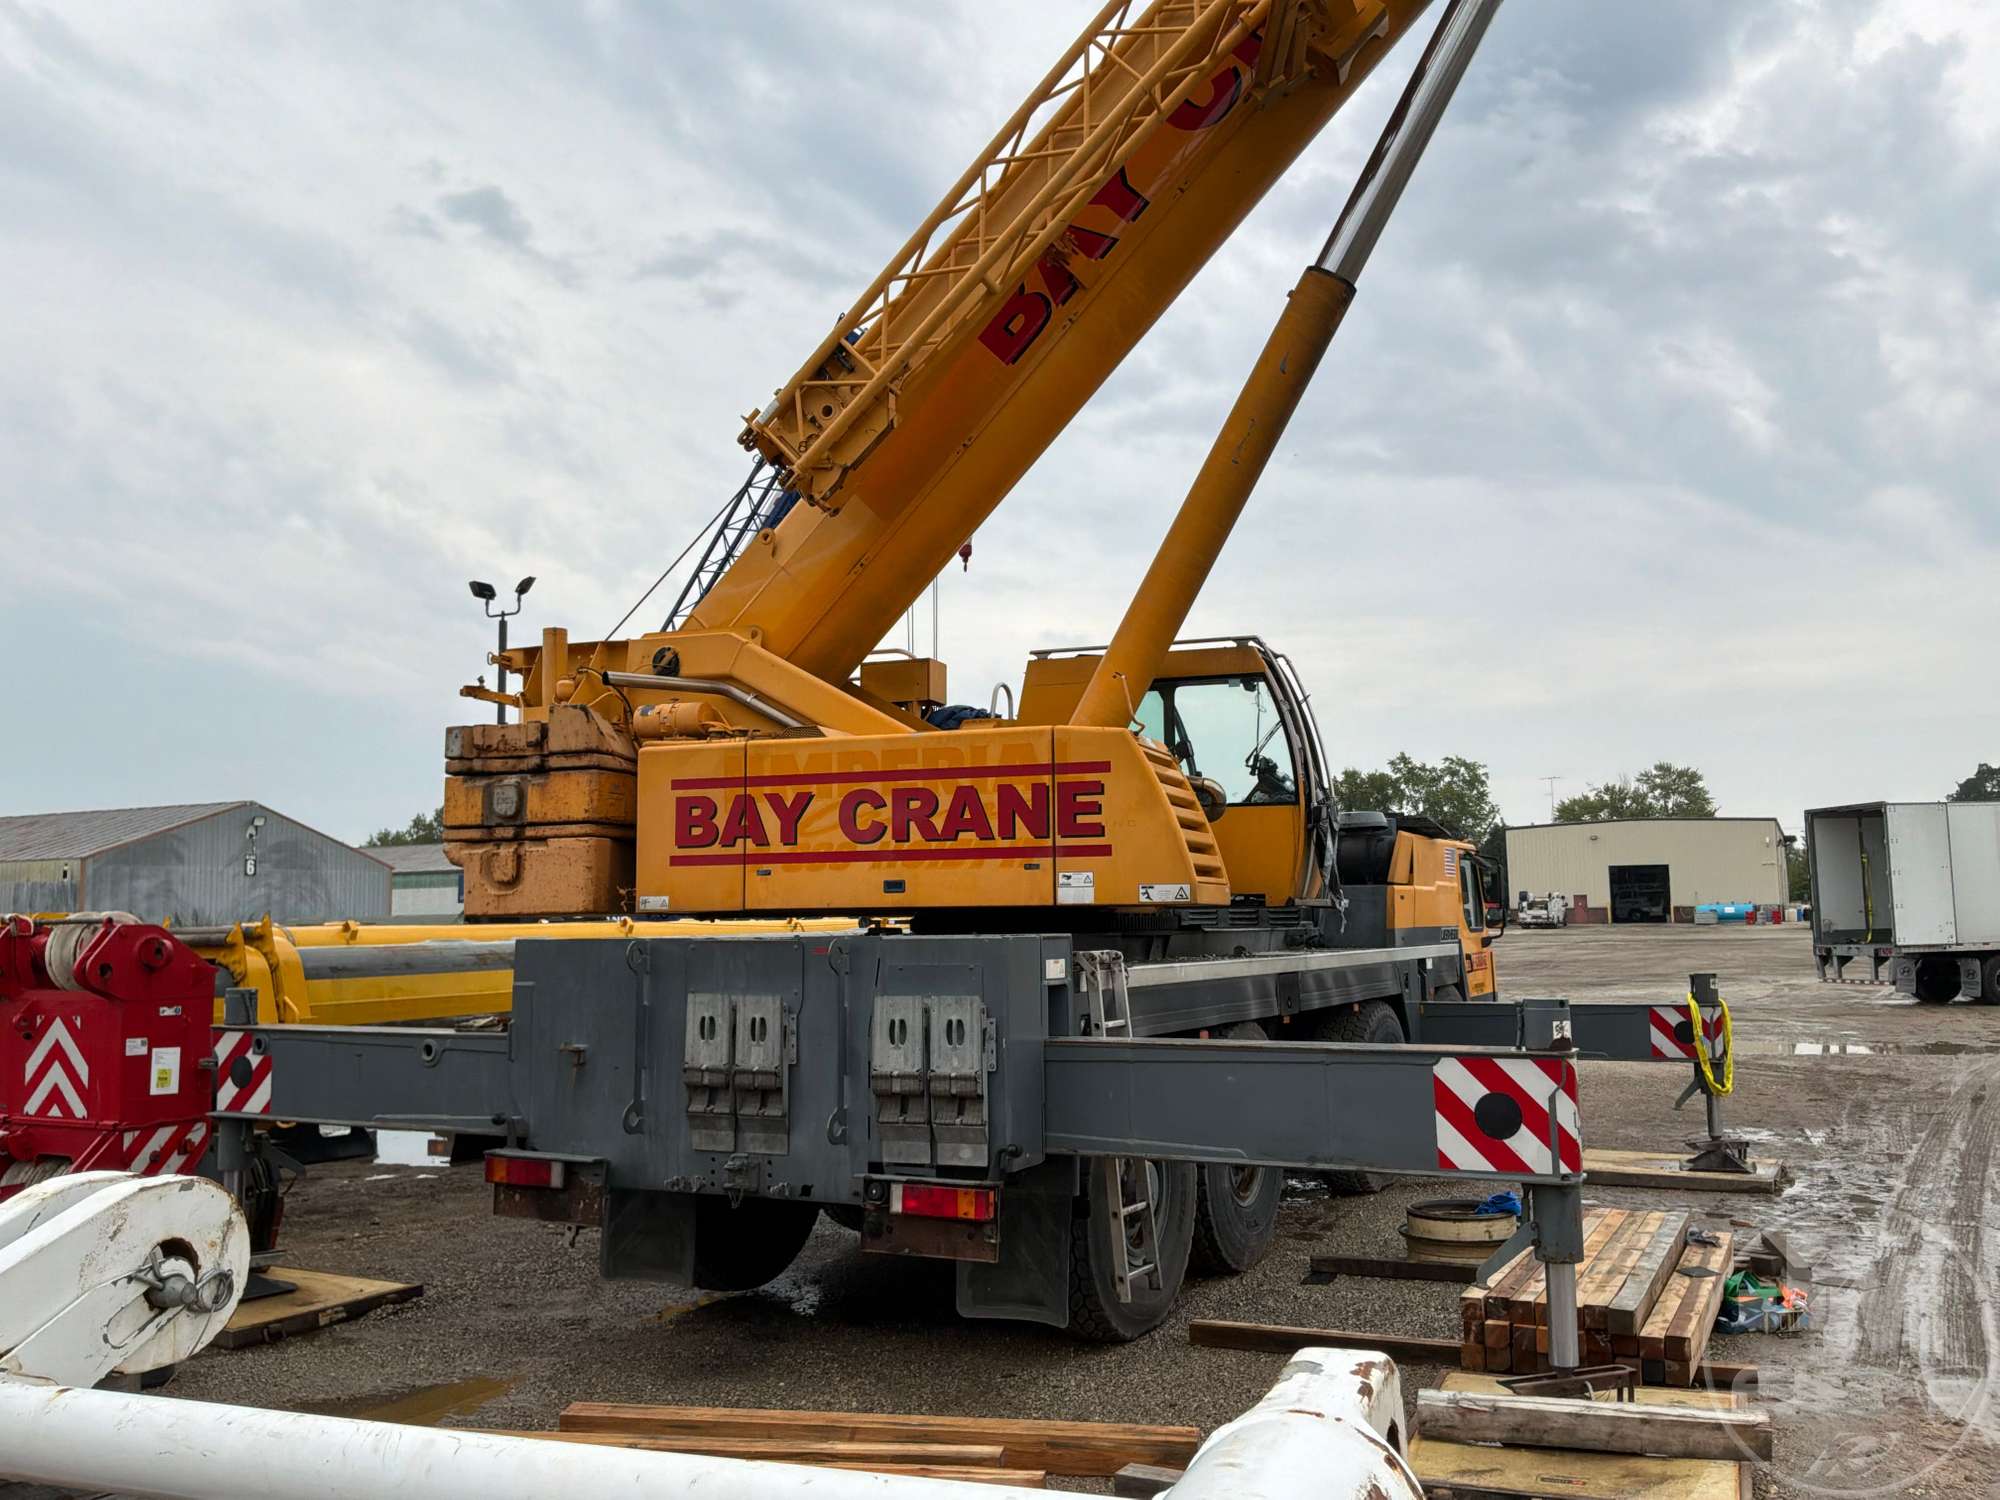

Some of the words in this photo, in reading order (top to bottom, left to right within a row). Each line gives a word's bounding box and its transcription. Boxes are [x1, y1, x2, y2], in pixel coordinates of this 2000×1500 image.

[675, 792, 816, 848] BAY
[838, 781, 1105, 838] CRANE
[246, 859, 255, 875] 6
